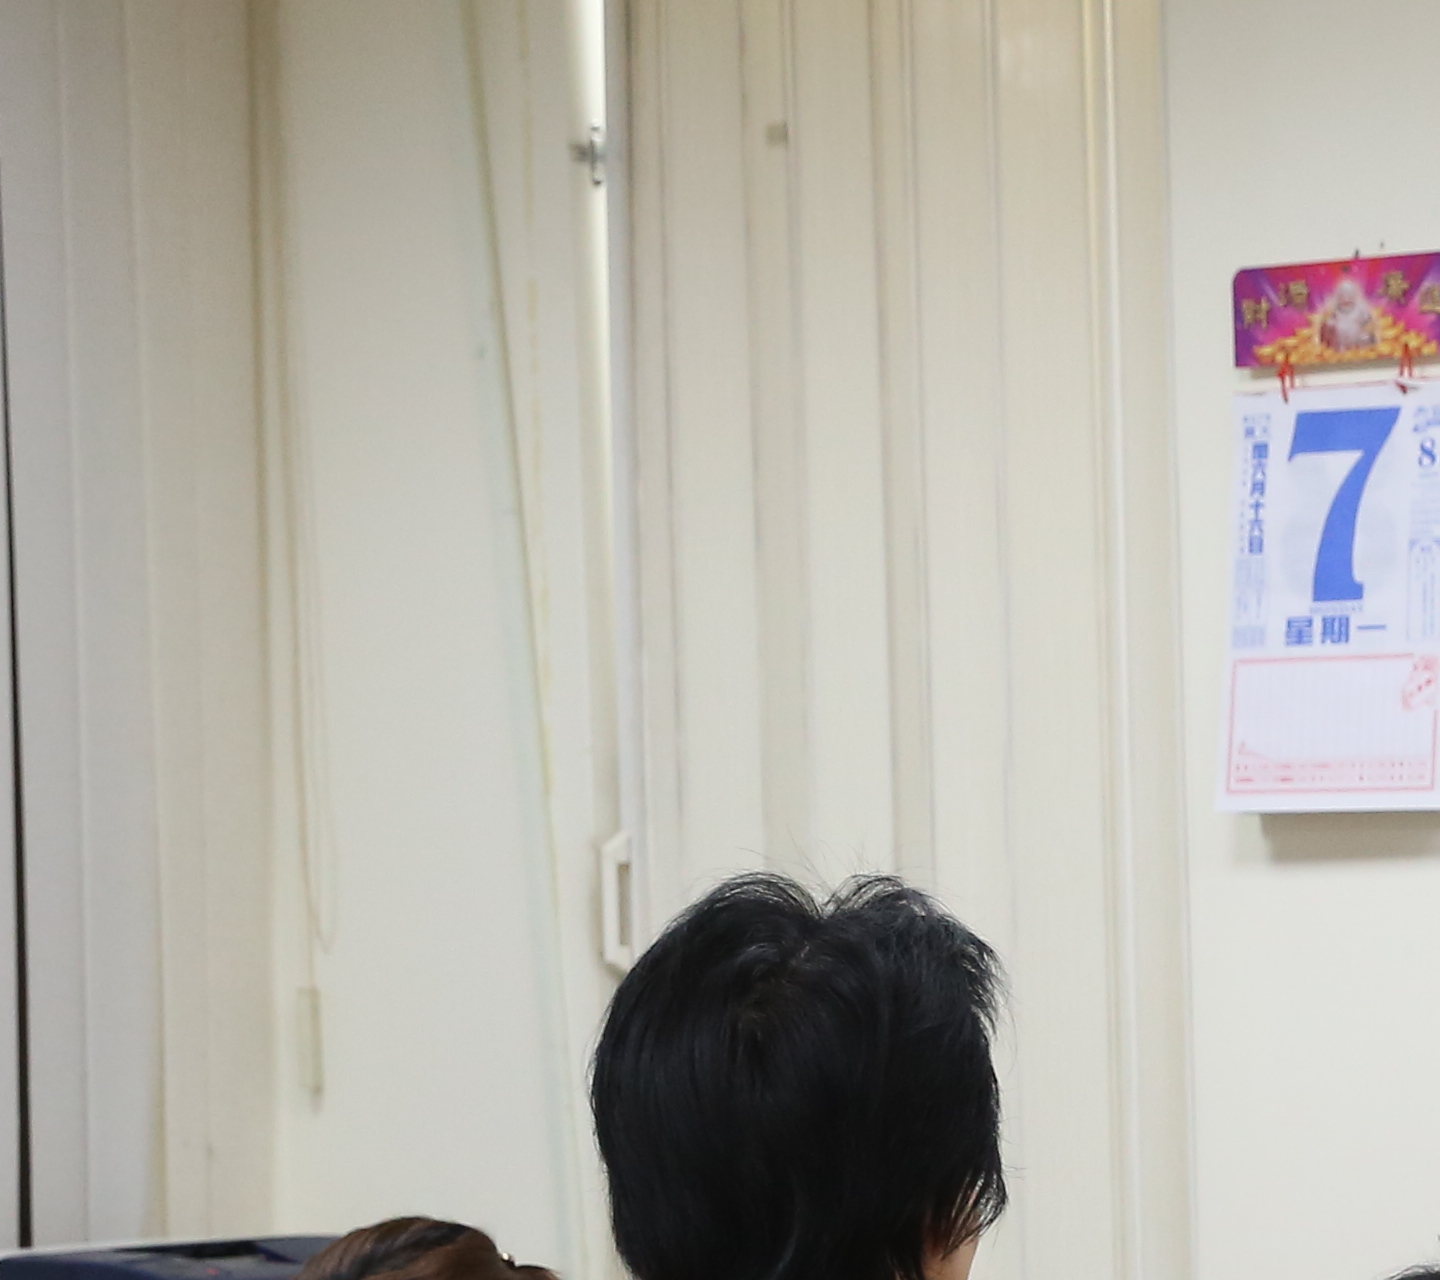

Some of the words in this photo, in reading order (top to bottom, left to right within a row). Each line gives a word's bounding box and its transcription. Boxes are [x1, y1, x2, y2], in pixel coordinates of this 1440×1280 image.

[1418, 438, 1438, 468] 8
[1288, 406, 1401, 603] 7
[1285, 614, 1387, 646] 星期一
